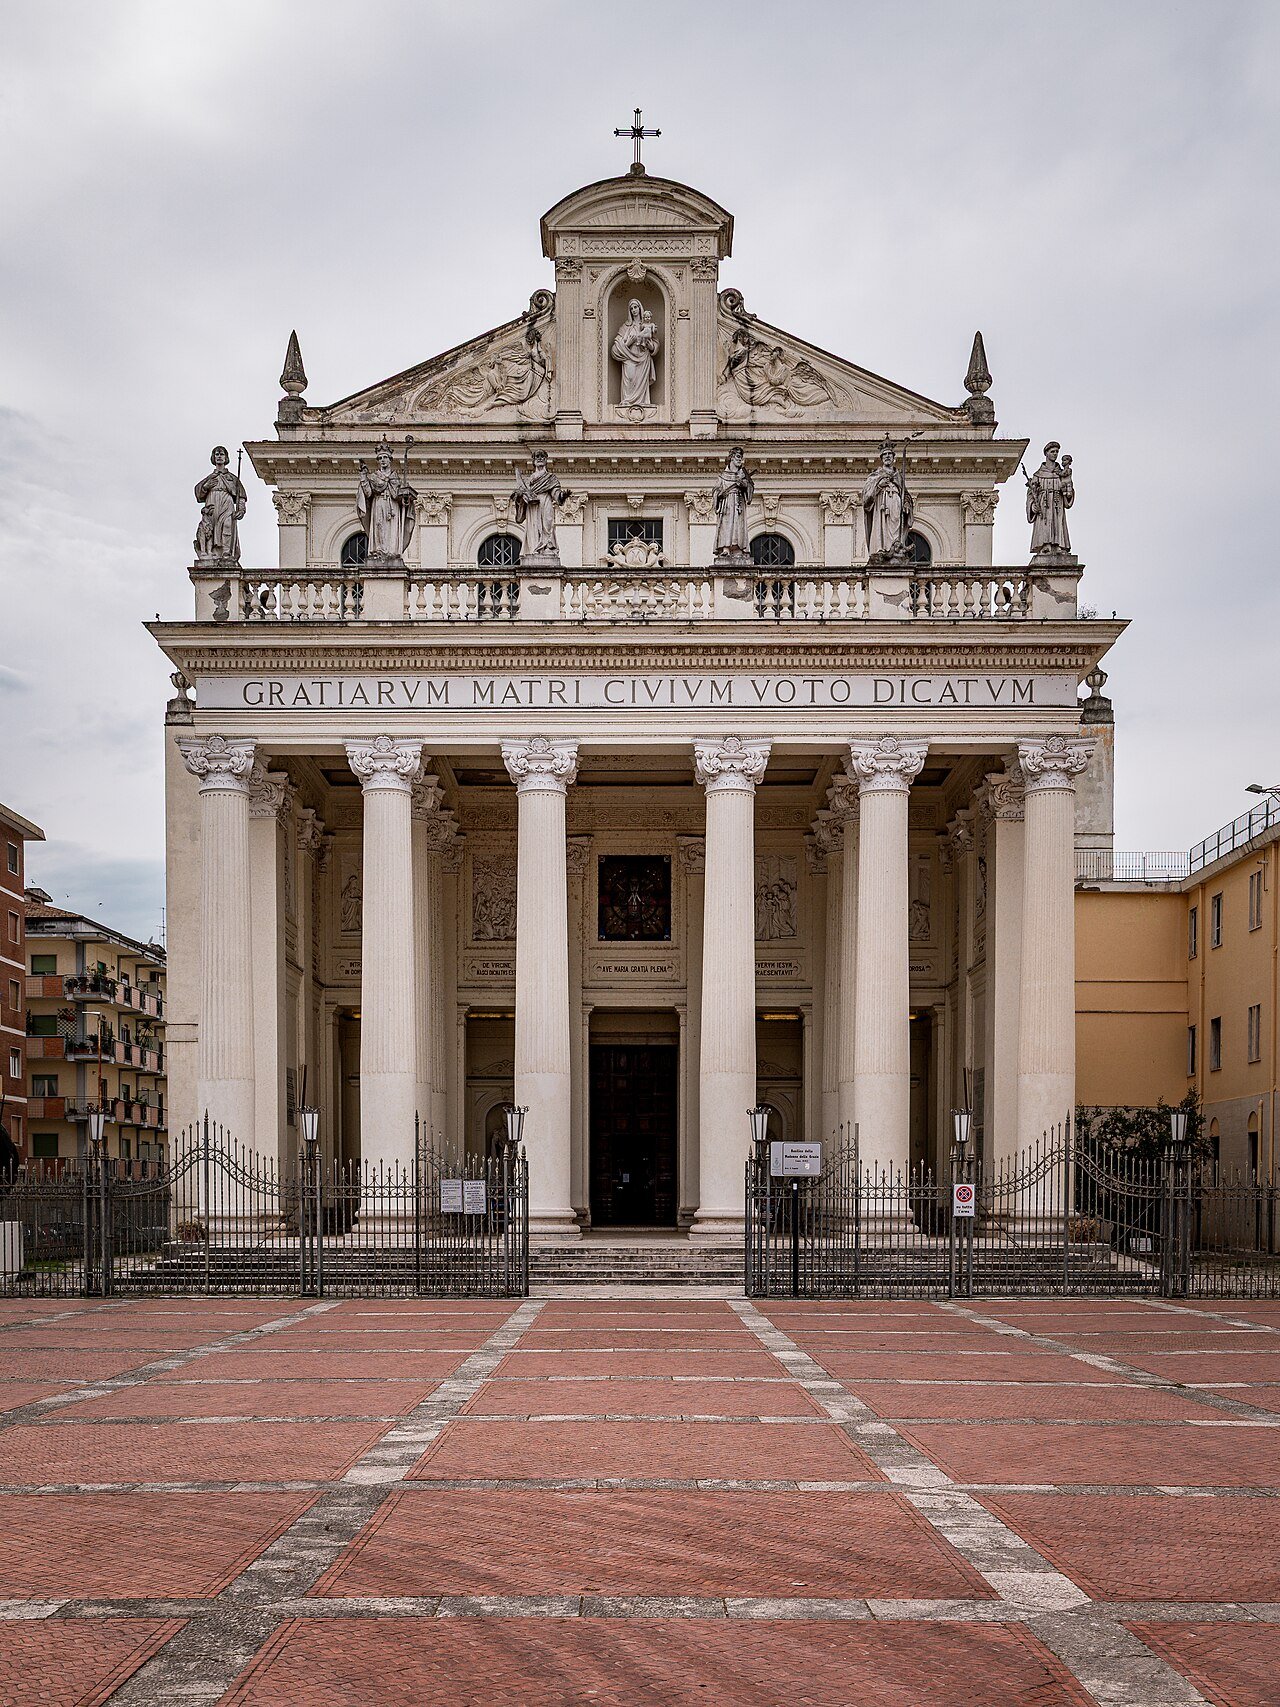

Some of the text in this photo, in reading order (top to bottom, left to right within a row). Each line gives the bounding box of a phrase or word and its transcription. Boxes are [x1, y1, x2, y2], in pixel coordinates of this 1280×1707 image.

[242, 679, 1035, 705] GRATIARVM MATRI CIVIVM VOTO DICATVM
[602, 965, 667, 973] AVE MARIA GRATIA PLENA
